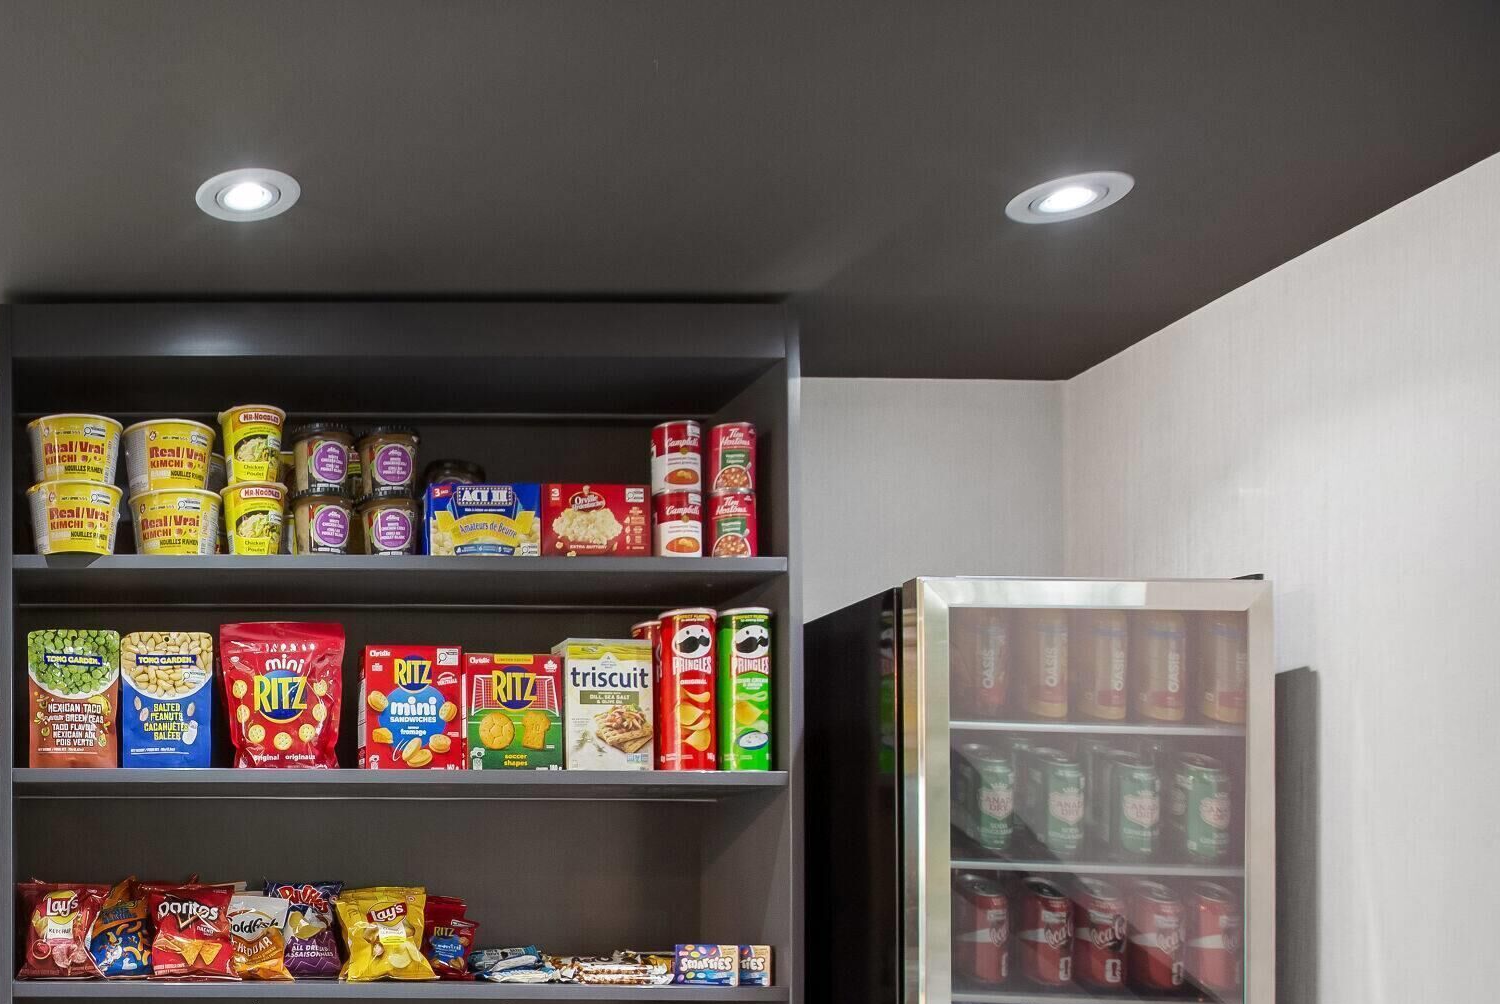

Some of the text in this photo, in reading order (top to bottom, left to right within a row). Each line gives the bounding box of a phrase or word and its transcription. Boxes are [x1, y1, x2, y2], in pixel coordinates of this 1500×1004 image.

[729, 428, 743, 438] Tim
[721, 436, 750, 446] Hortons
[46, 454, 77, 466] KIMCHI
[151, 460, 184, 469] KIMCHI
[434, 488, 441, 497] 3
[462, 489, 508, 502] ACT II
[551, 488, 560, 497] 3
[724, 496, 739, 506] Tim
[716, 506, 748, 516] Hortons
[51, 520, 84, 531] KIMCHI
[460, 522, 489, 536] Amateurs
[143, 528, 172, 541] KIMCHI
[45, 655, 99, 665] TONG GARDEN
[138, 656, 192, 665] TONG GARDEN
[265, 654, 305, 674] mini
[672, 656, 712, 675] PRINGLES
[394, 658, 433, 686] RITZ
[982, 648, 995, 689] OASIS
[1045, 647, 1060, 688] OASIS
[1113, 650, 1125, 691] OASIS
[1167, 650, 1181, 693] OASIS
[570, 666, 649, 689] triscuit
[492, 670, 538, 702] RITZ
[253, 675, 308, 713] RITZ
[48, 703, 102, 714] MEXICAN TACO
[153, 703, 181, 712] SALTED
[390, 696, 437, 716] mini
[65, 713, 104, 724] GREEN PEAS
[150, 712, 184, 721] PEANUTS
[52, 723, 69, 731] TACO
[400, 728, 427, 737] fromage
[52, 730, 83, 739] MEXICAIN
[55, 738, 95, 747] POIS VERTS
[253, 753, 280, 762] original
[503, 759, 528, 768] shapes
[371, 904, 404, 922] Lay's
[229, 917, 279, 934] oldfish
[433, 926, 456, 937] RITZ
[740, 956, 765, 971] TIES
